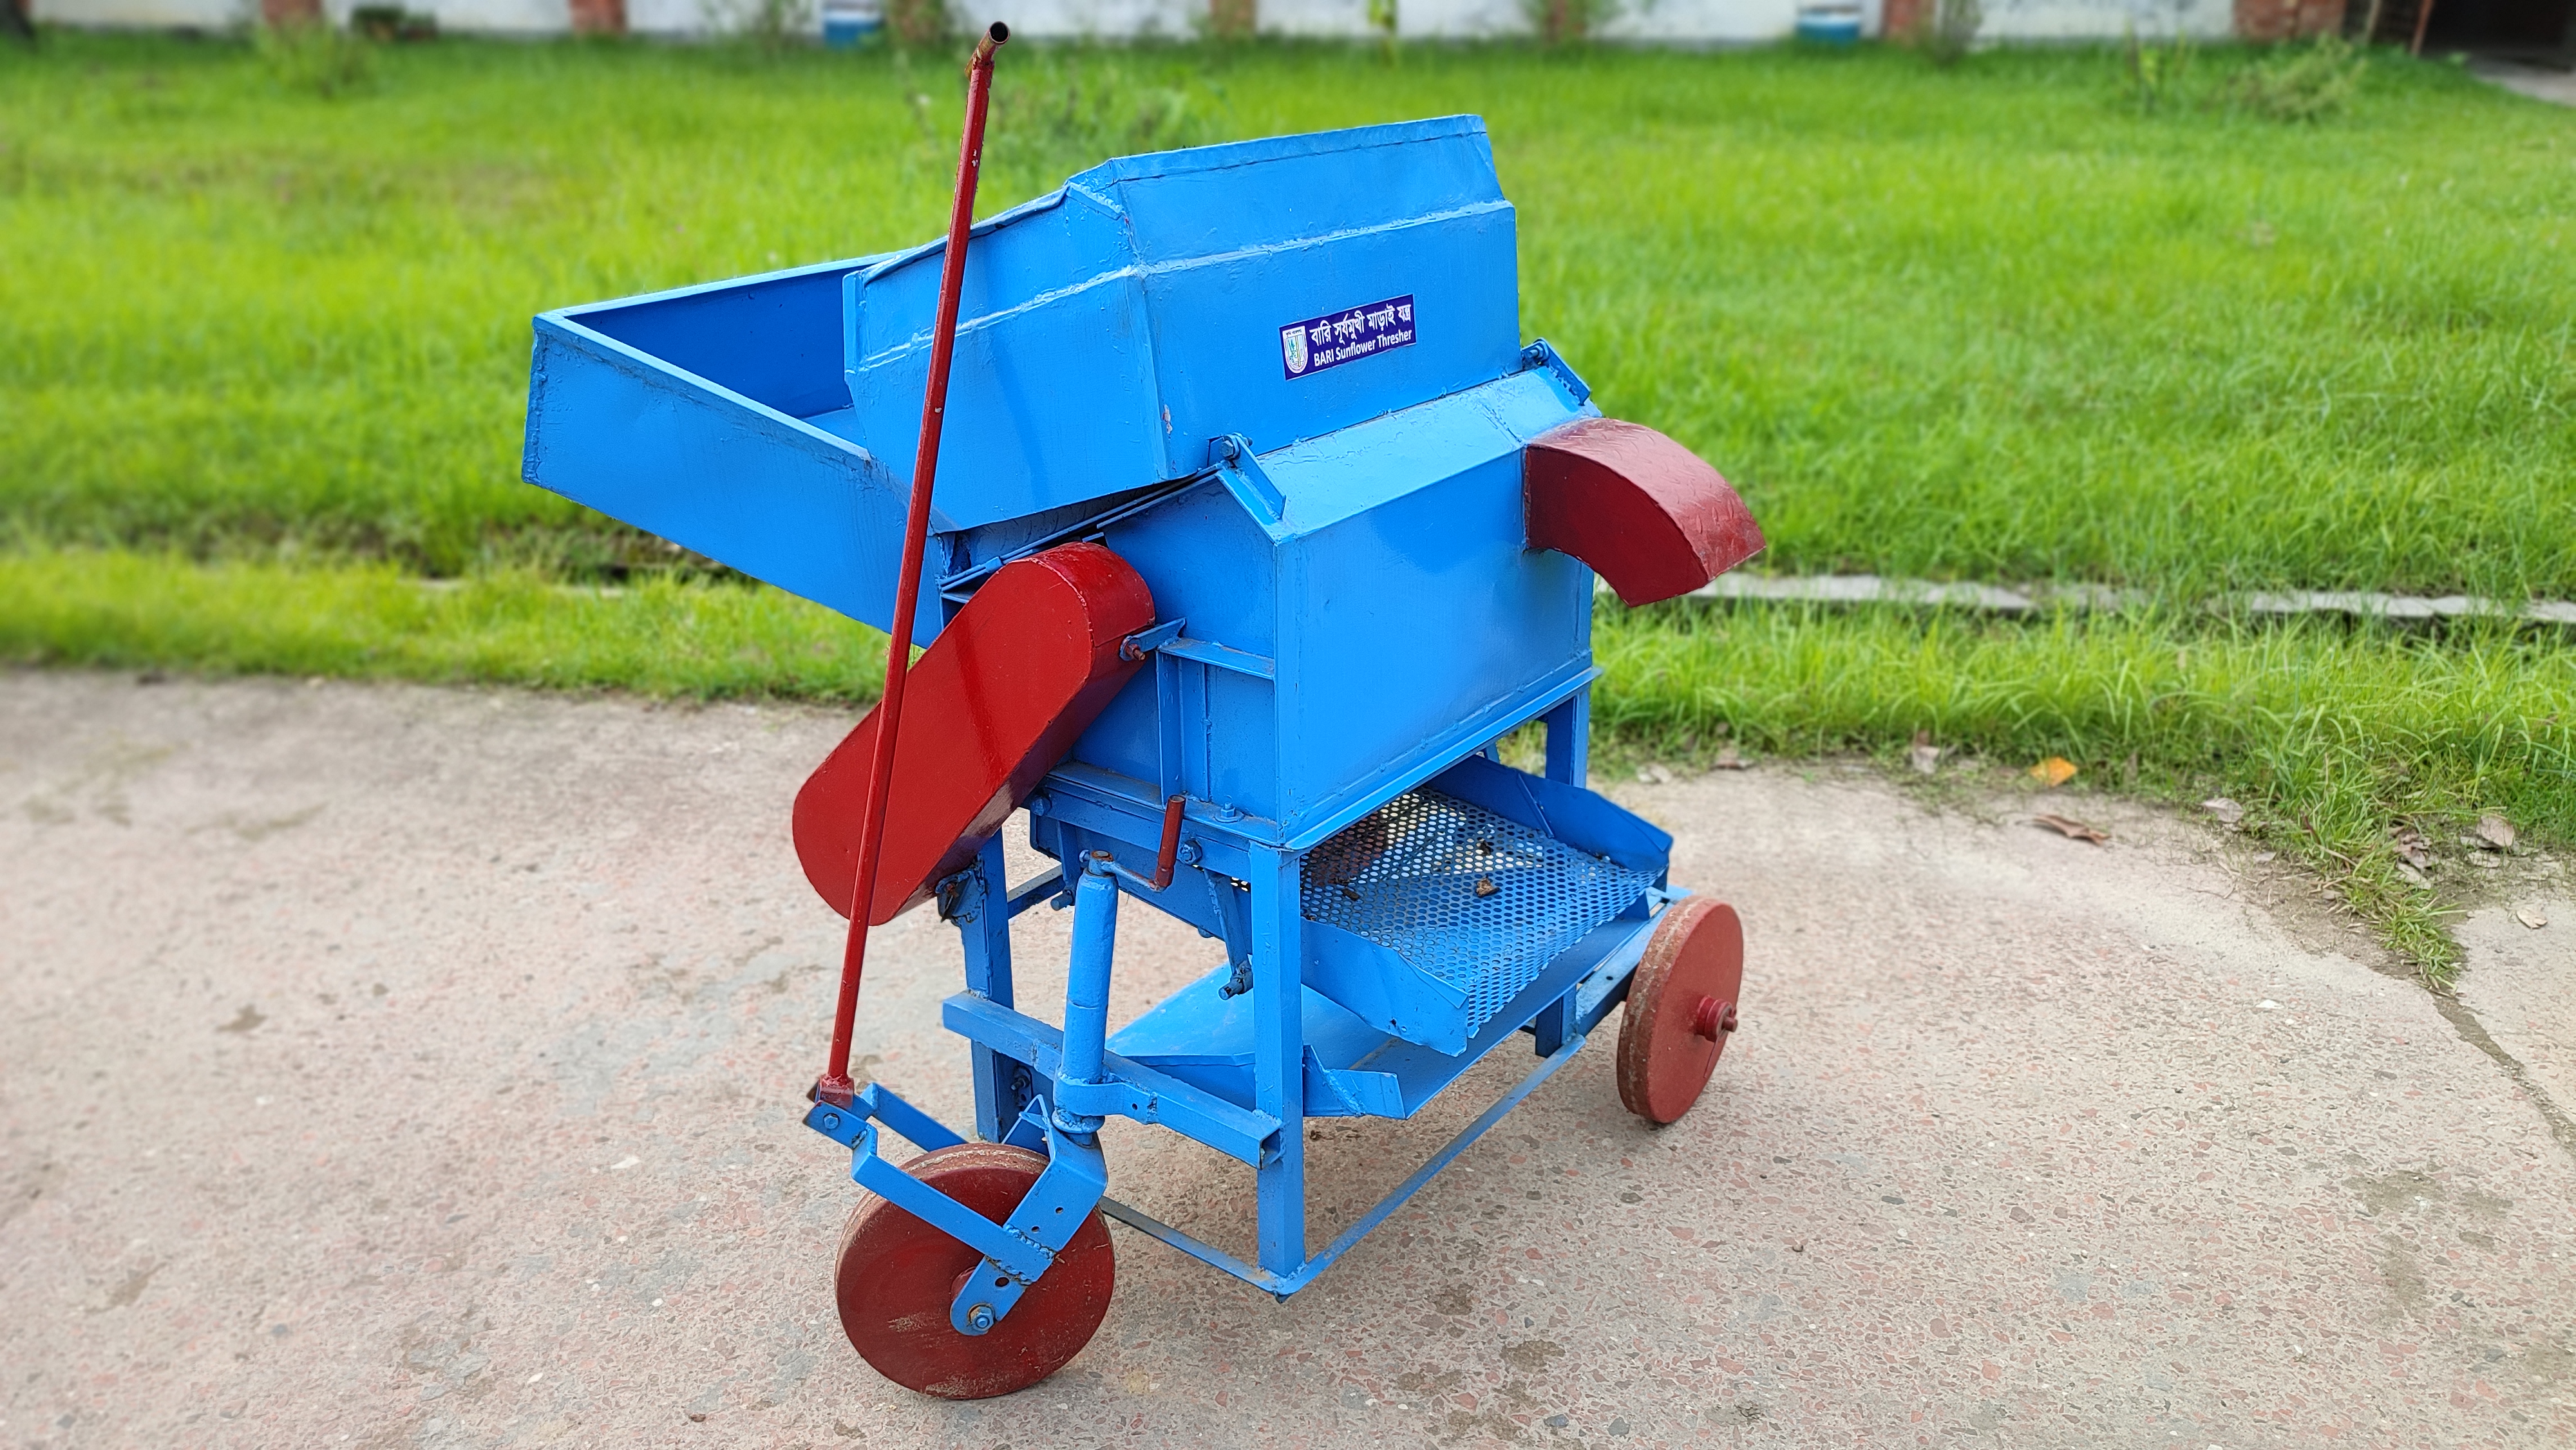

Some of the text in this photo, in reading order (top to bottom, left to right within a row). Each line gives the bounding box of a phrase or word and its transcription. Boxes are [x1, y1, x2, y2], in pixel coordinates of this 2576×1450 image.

[1309, 320, 1332, 346] বারি
[1367, 303, 1396, 332] মাড়াই
[1314, 328, 1412, 366] BARI Sunflower Thresher
